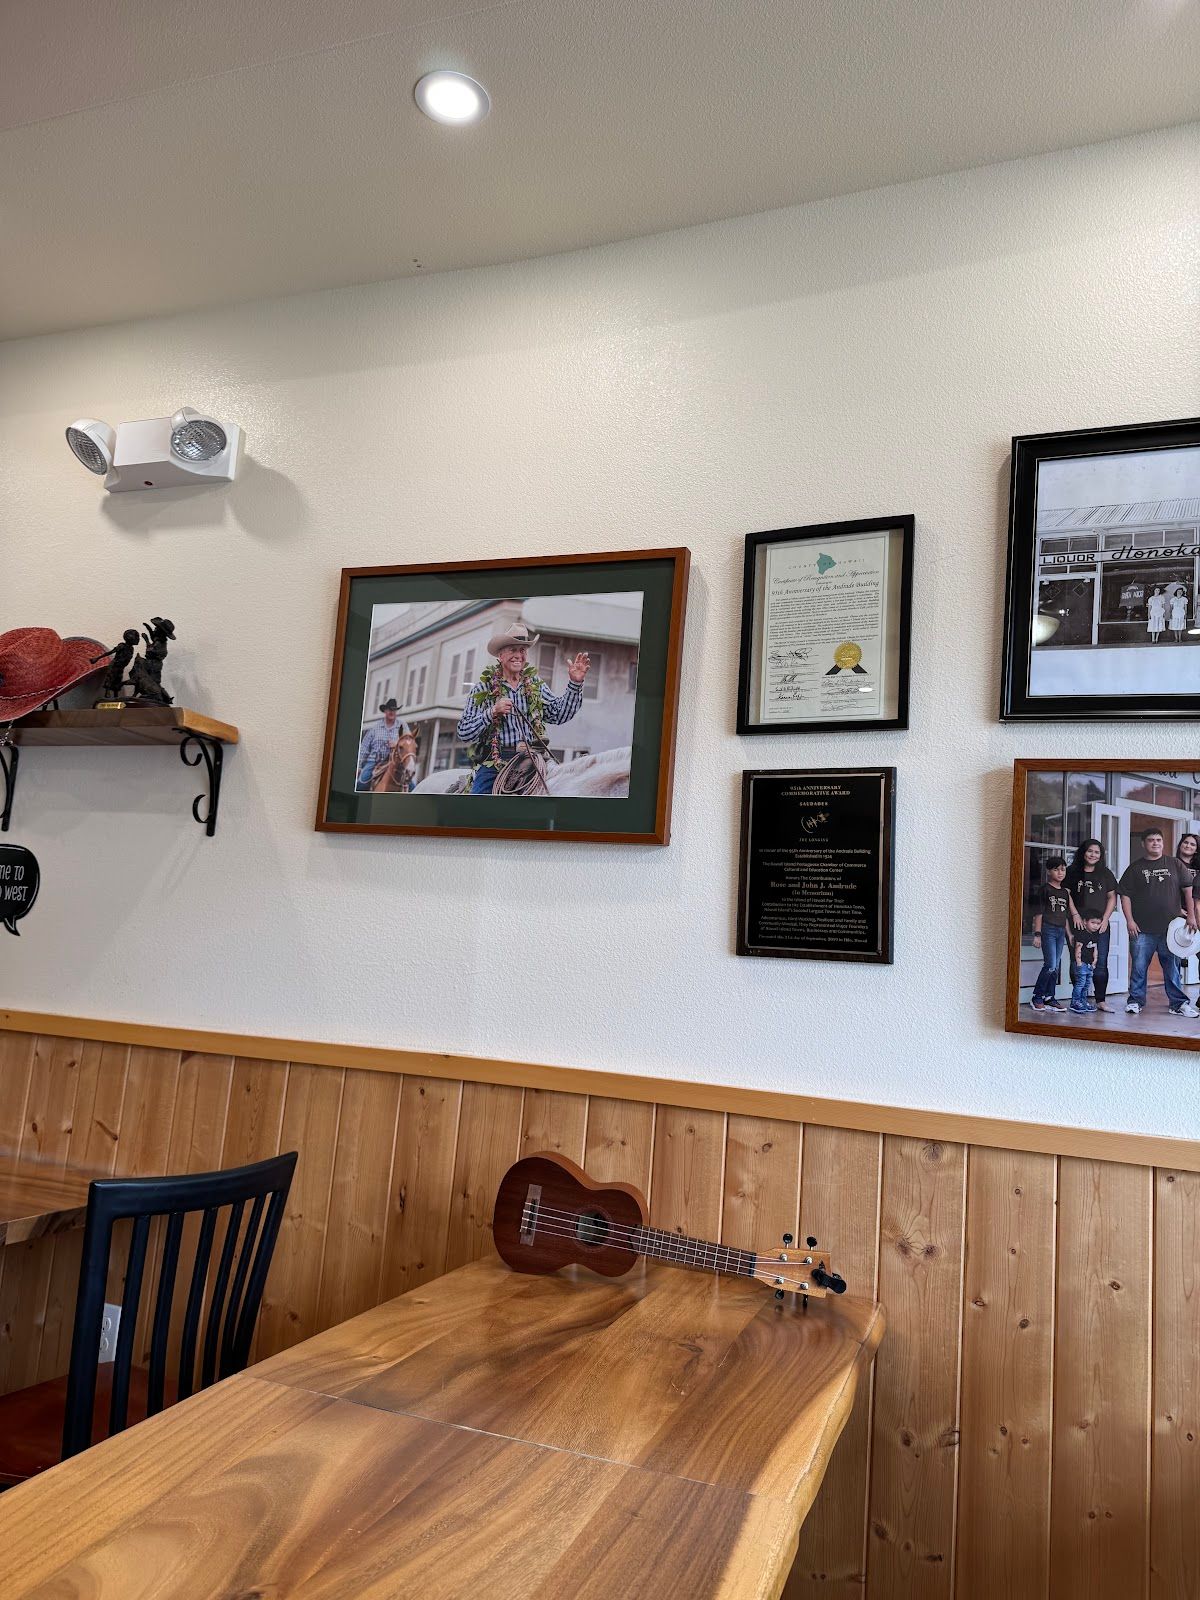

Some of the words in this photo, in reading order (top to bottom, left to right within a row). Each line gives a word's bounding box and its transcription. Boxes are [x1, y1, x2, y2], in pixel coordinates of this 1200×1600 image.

[1042, 553, 1095, 564] LIQUOR
[783, 587, 815, 595] Anniversary
[831, 581, 854, 590] Andrade
[855, 580, 879, 588] Building
[801, 881, 818, 889] John
[827, 882, 857, 890] Andrade
